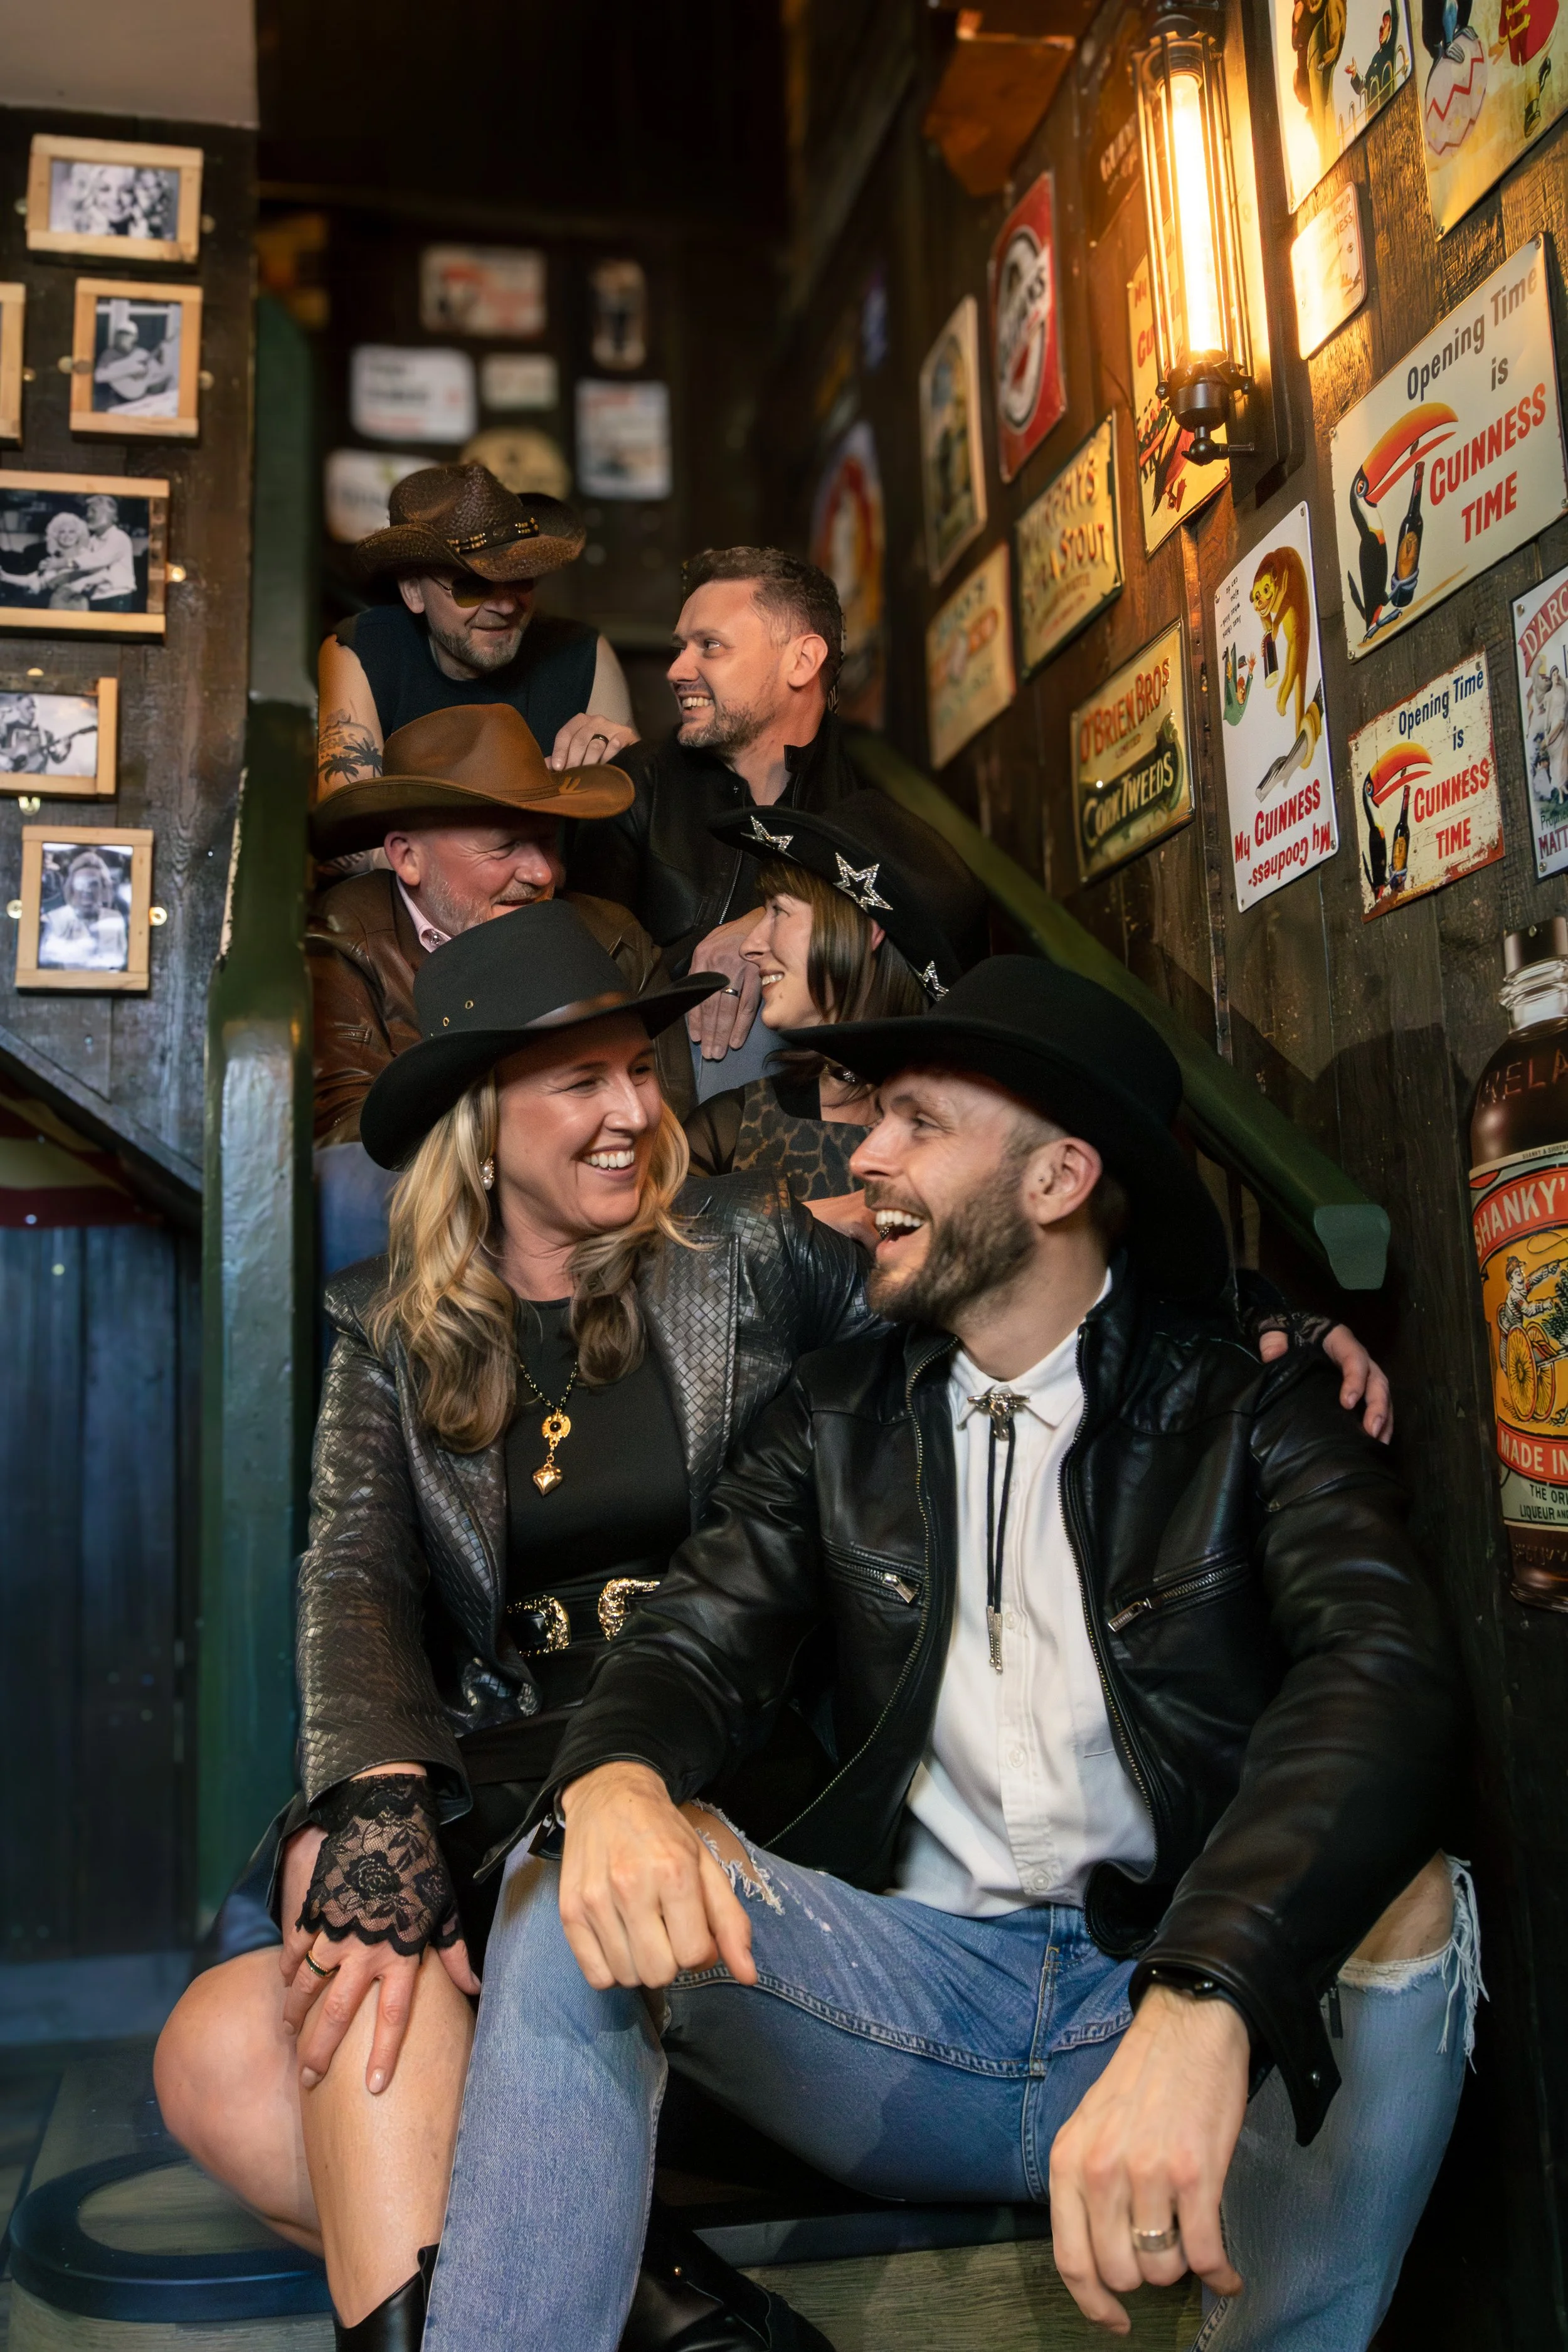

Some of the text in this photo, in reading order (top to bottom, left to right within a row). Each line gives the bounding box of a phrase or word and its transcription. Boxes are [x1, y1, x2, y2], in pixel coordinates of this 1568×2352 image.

[1407, 267, 1537, 403] Opening Time
[1491, 356, 1508, 392] is
[1429, 383, 1546, 507] GUINNESS
[1461, 470, 1518, 544] TIME
[1080, 687, 1137, 765] O'BRIEN
[1399, 670, 1484, 739] Opening Time
[1453, 726, 1464, 751] is
[1119, 751, 1174, 818] TWEEDS
[1413, 756, 1490, 824] GUINNESS
[1235, 778, 1321, 864] My GUINNESS
[1313, 821, 1330, 856] My
[1436, 816, 1471, 861] TIME
[1475, 1177, 1566, 1258] SHANKY'
[1501, 1430, 1568, 1476] MADE IN
[1520, 1503, 1555, 1521] LIQUEUR
[1530, 1483, 1568, 1506] THE ORI
